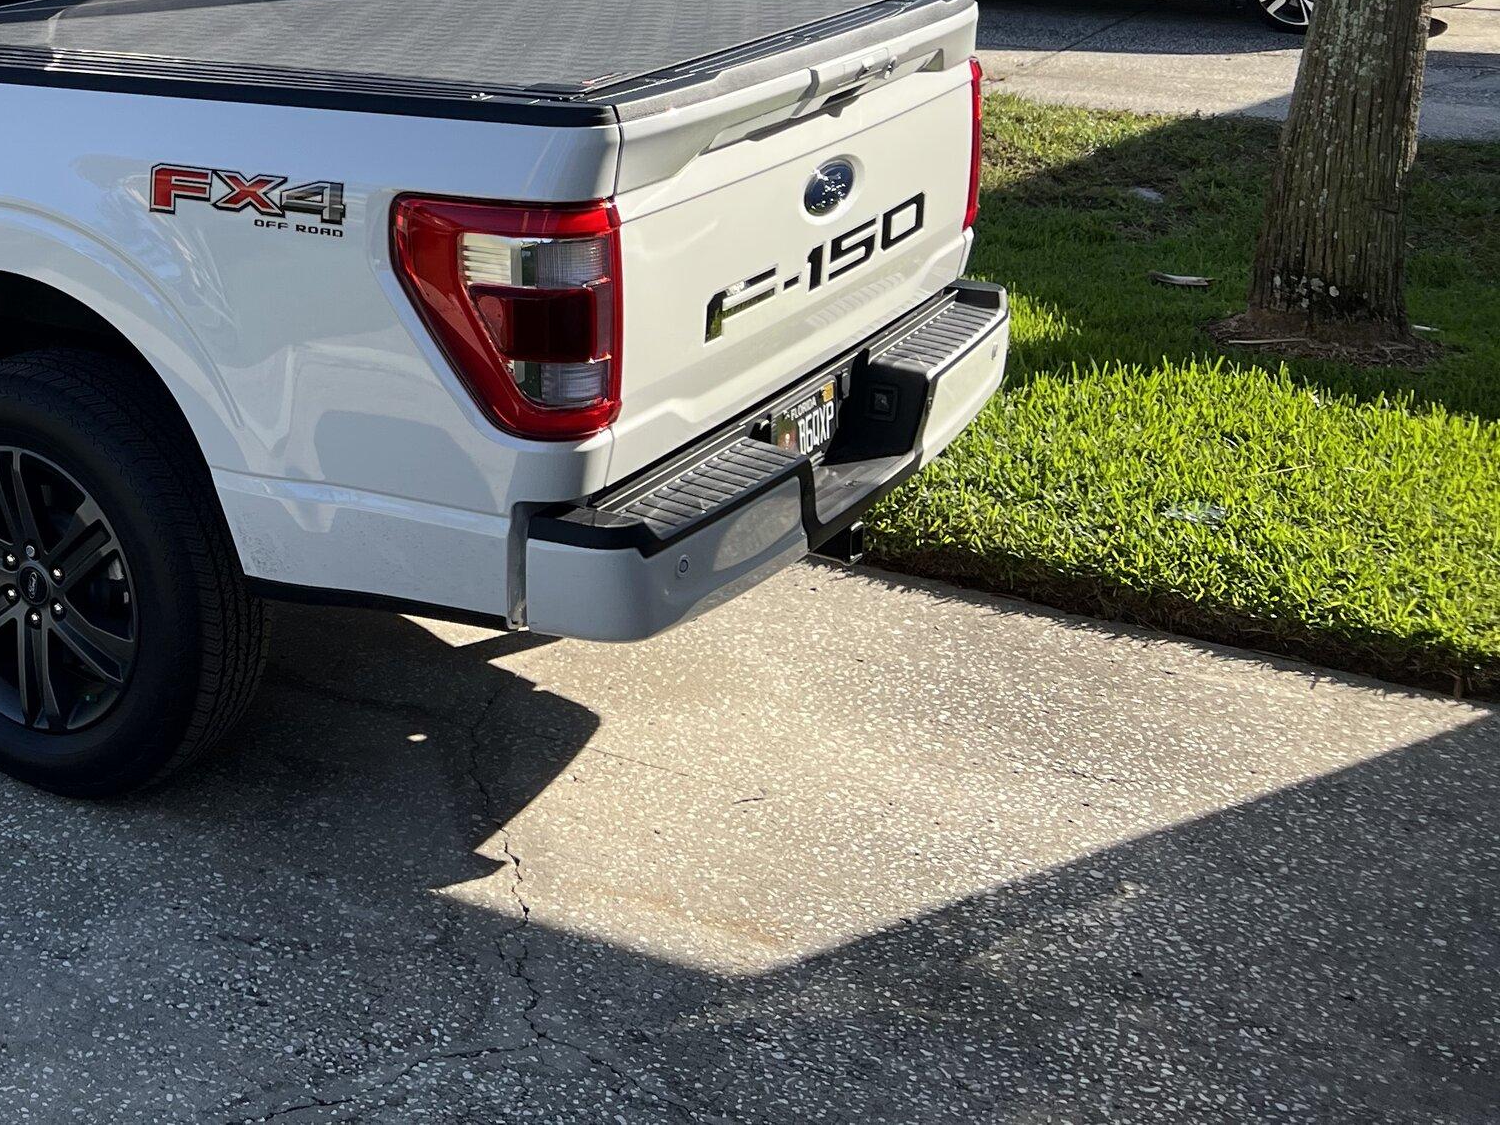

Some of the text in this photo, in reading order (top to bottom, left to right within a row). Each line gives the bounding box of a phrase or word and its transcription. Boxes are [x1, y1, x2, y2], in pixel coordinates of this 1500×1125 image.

[150, 163, 346, 225] FX4
[253, 218, 344, 238] OFF ROAD
[705, 192, 924, 343] F-150
[790, 395, 818, 421] FLORIDA
